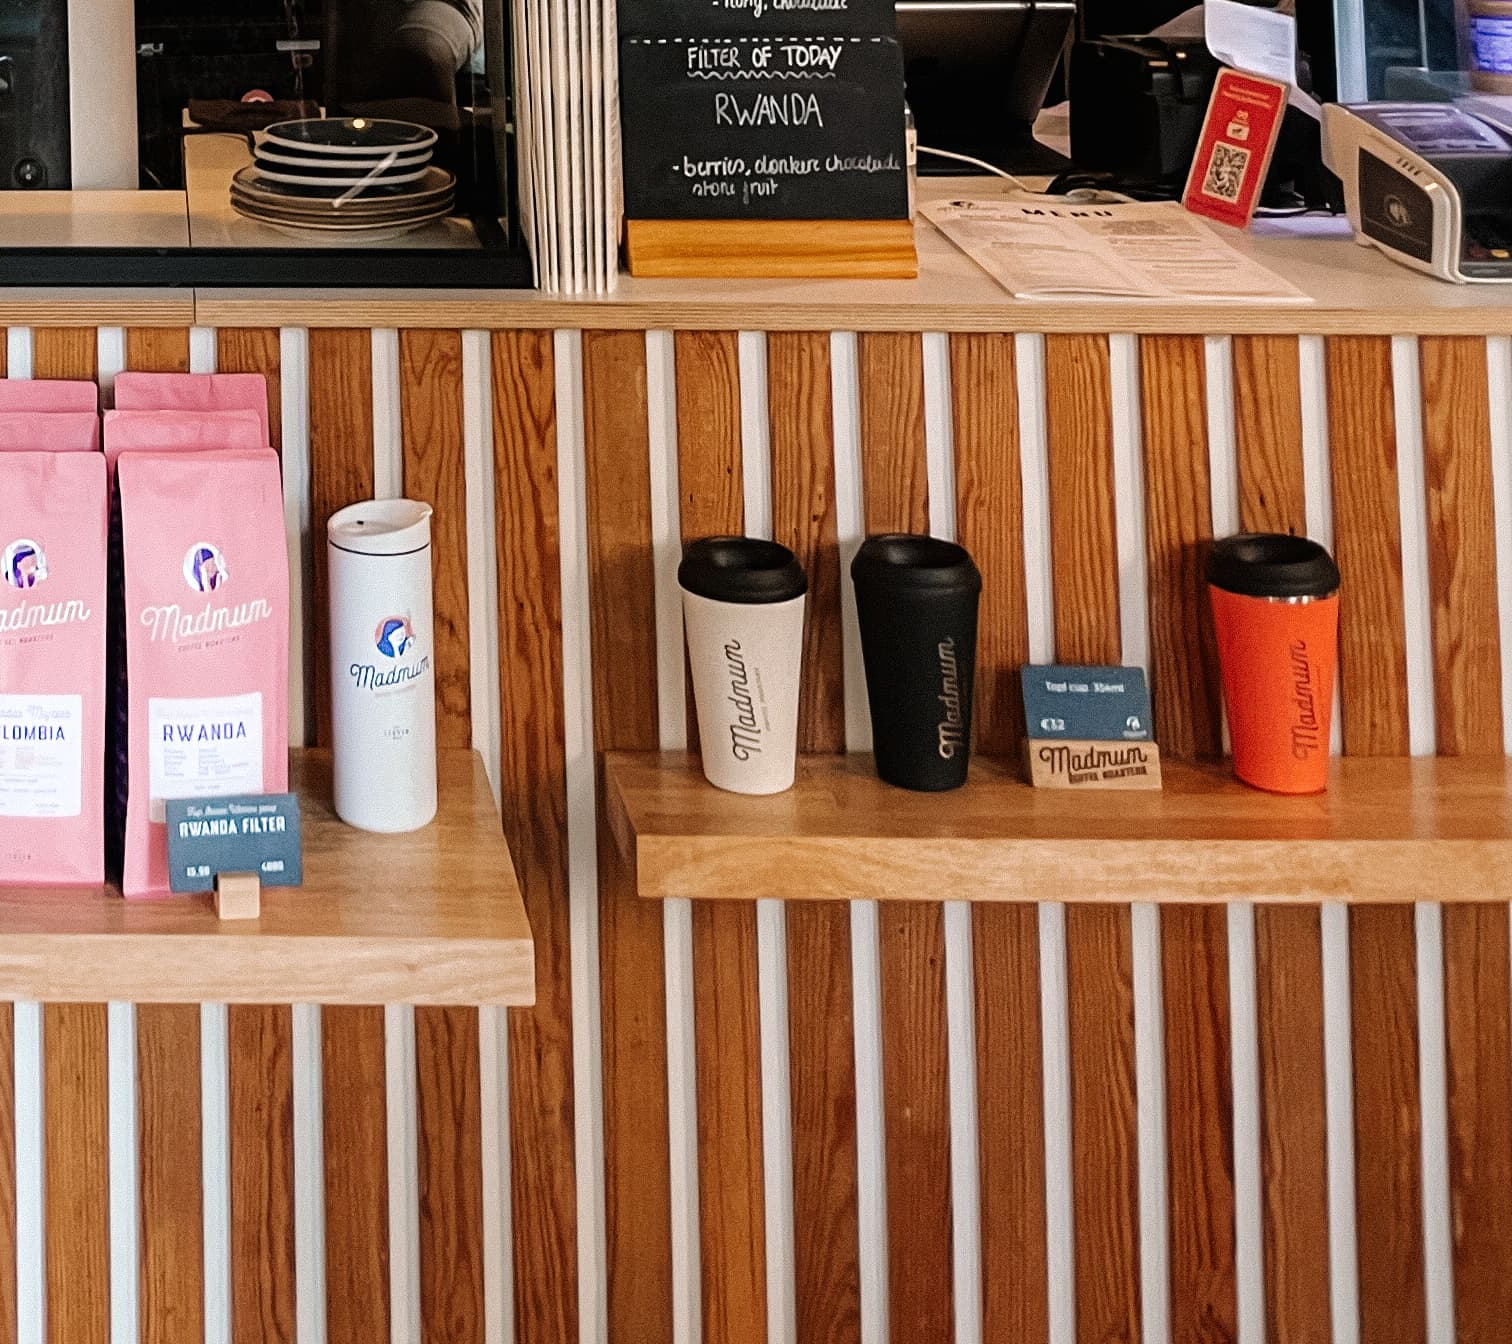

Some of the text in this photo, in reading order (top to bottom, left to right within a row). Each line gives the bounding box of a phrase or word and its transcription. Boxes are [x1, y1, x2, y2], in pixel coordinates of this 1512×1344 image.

[752, 46, 772, 68] OF
[780, 46, 842, 70] TODAY
[716, 93, 824, 128] RWANDA
[140, 597, 272, 643] Madmum
[724, 639, 762, 762] Madmum
[937, 636, 965, 760] Madmum
[163, 720, 248, 743] RWANDA
[1039, 746, 1148, 775] Madmum
[178, 815, 286, 838] RWANDA FILTER
